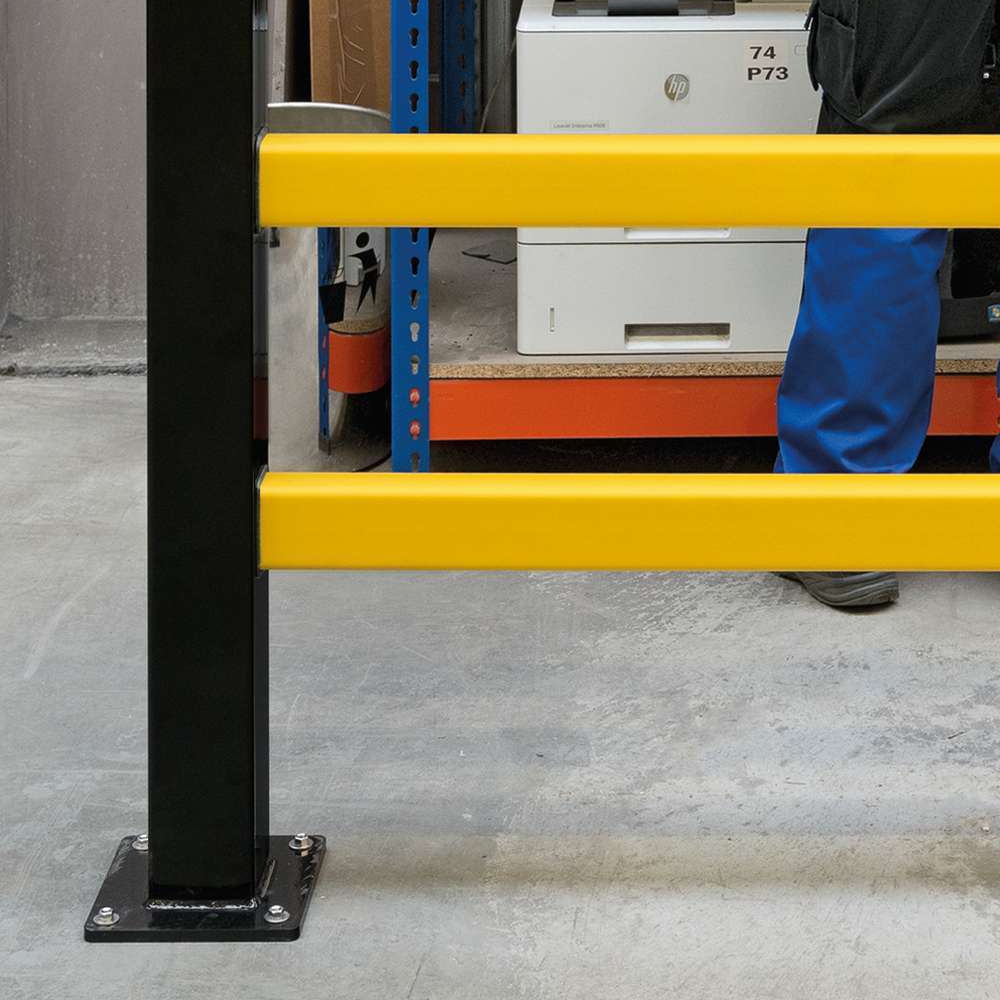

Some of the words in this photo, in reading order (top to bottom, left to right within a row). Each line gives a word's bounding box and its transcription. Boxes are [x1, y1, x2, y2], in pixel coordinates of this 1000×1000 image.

[750, 46, 776, 59] 74
[747, 66, 789, 81] P73
[667, 74, 688, 102] hp
